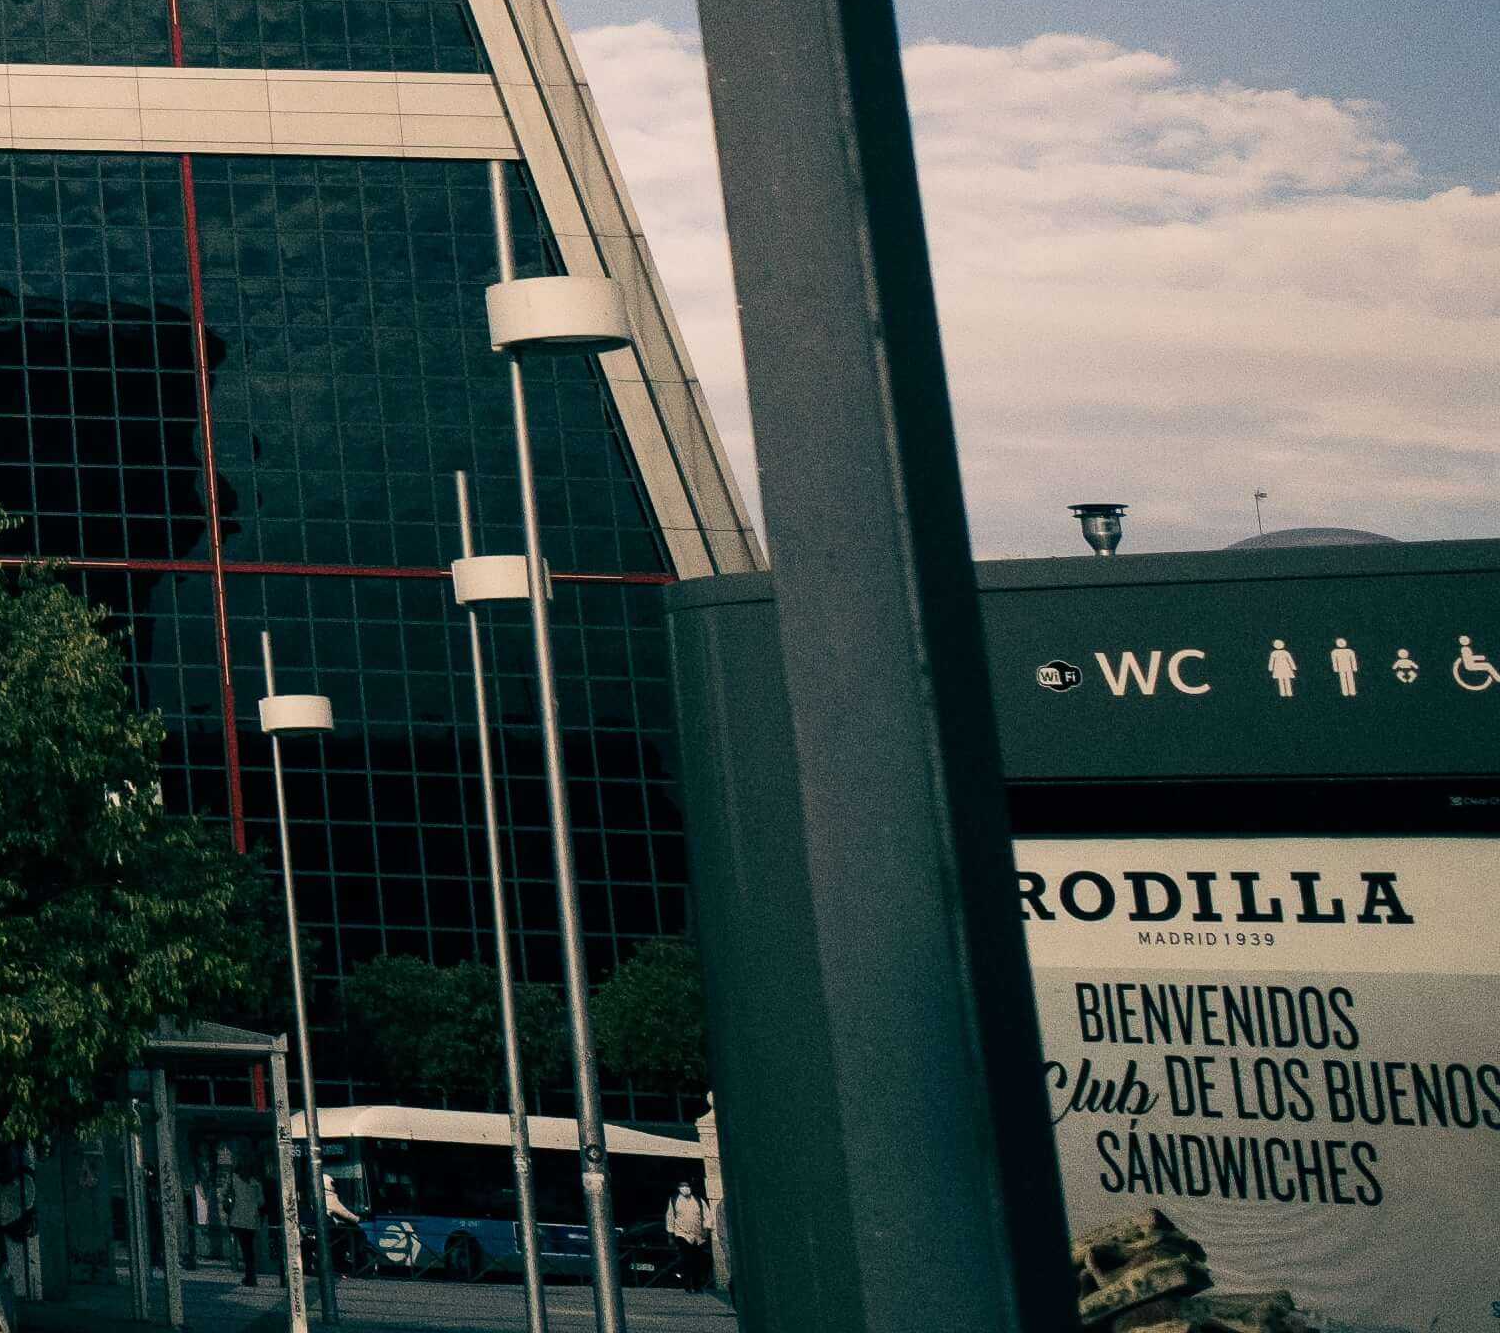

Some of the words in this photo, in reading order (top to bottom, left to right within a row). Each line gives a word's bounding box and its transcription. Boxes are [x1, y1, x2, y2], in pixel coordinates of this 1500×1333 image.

[1094, 648, 1212, 696] WC
[1014, 870, 1415, 925] RODILLA
[1138, 931, 1217, 946] MADRID
[1224, 932, 1276, 946] 1939
[1074, 982, 1360, 1051] BIENVENIDOS
[1164, 1056, 1223, 1119] DE
[1230, 1056, 1315, 1123] LOS
[1323, 1059, 1500, 1131] BUENOS
[1096, 1119, 1384, 1207] SÁNDWICHES
